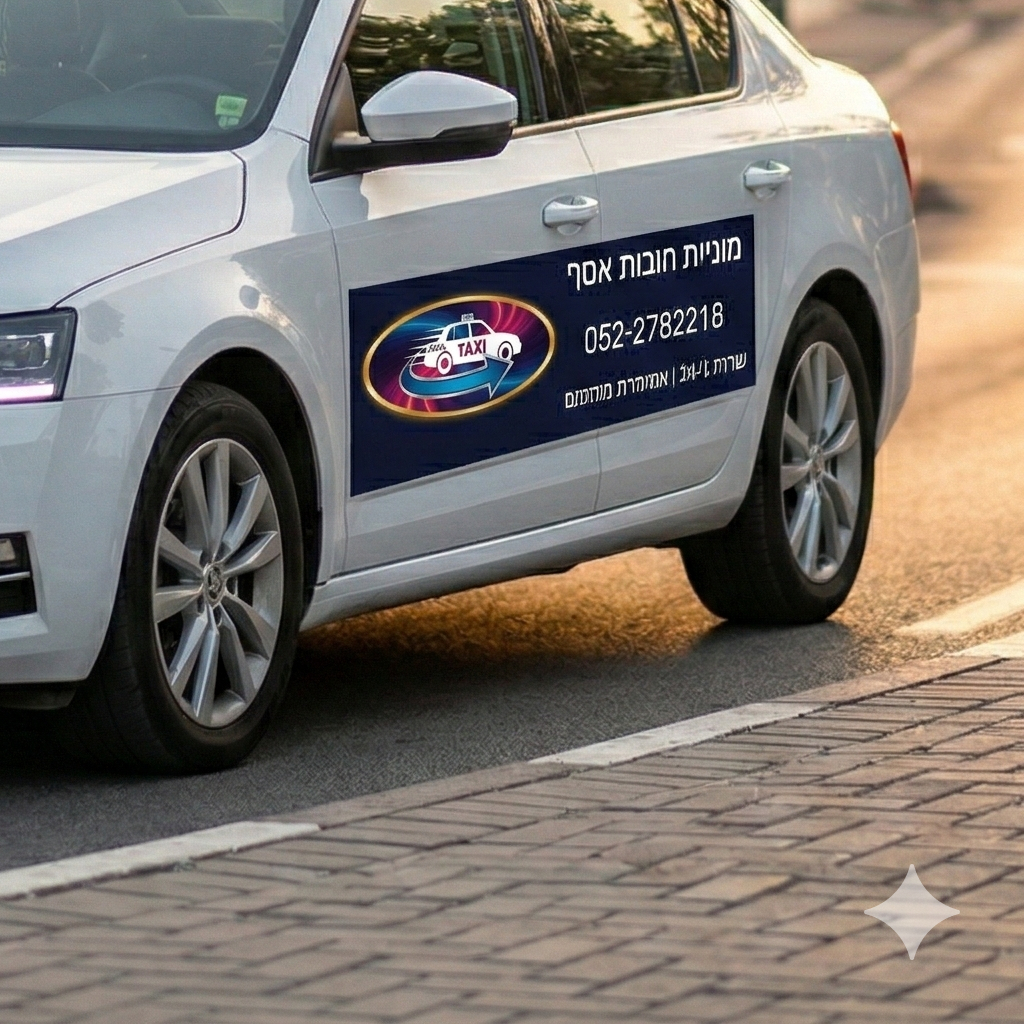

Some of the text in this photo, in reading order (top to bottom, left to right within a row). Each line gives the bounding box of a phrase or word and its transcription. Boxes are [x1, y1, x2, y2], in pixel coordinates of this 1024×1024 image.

[567, 236, 742, 292] מוניות חובות אסף
[457, 338, 487, 358] TAXI
[584, 301, 724, 354] 052-2782218
